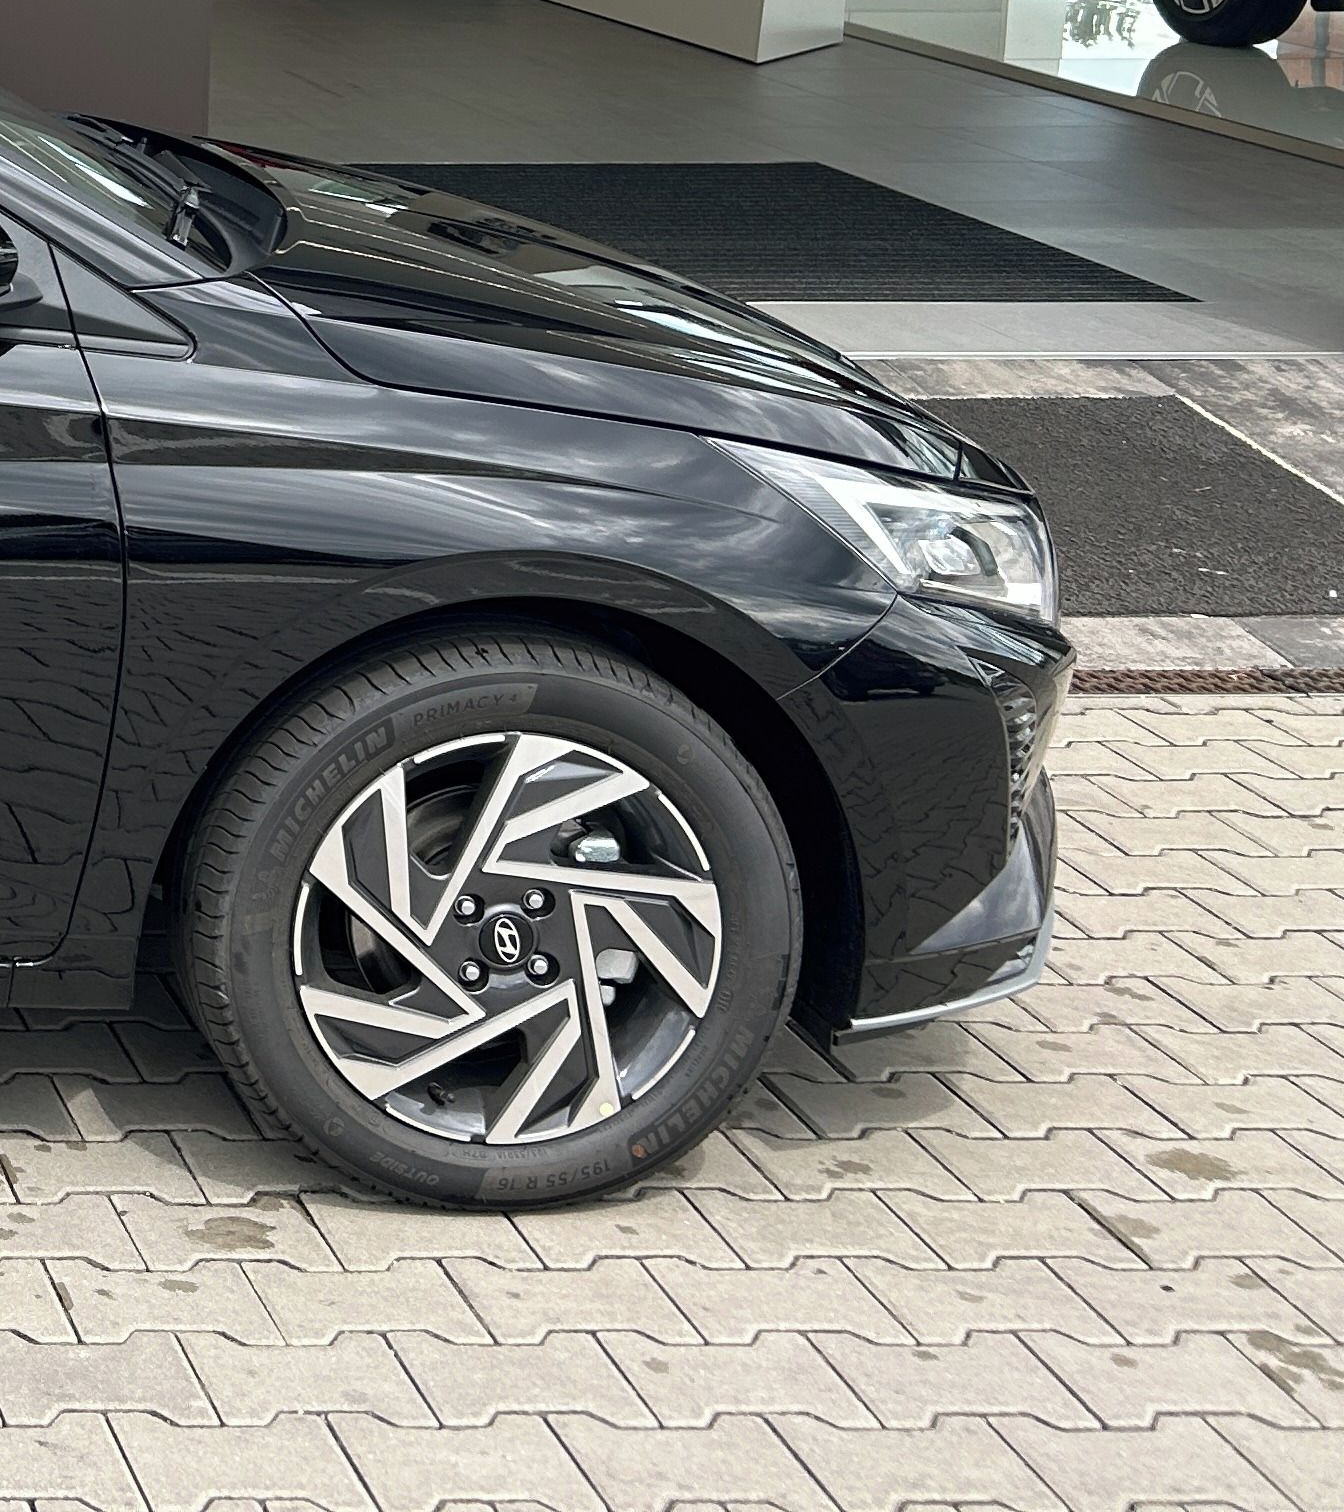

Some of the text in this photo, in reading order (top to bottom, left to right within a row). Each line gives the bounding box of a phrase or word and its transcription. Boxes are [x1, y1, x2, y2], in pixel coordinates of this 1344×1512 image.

[269, 725, 388, 863] MICHELIN
[413, 694, 502, 727] PRIMACY
[368, 1150, 440, 1187] OUTSIDE
[497, 1176, 521, 1192] 16
[525, 1175, 539, 1190] R
[545, 1158, 610, 1189] 195/55
